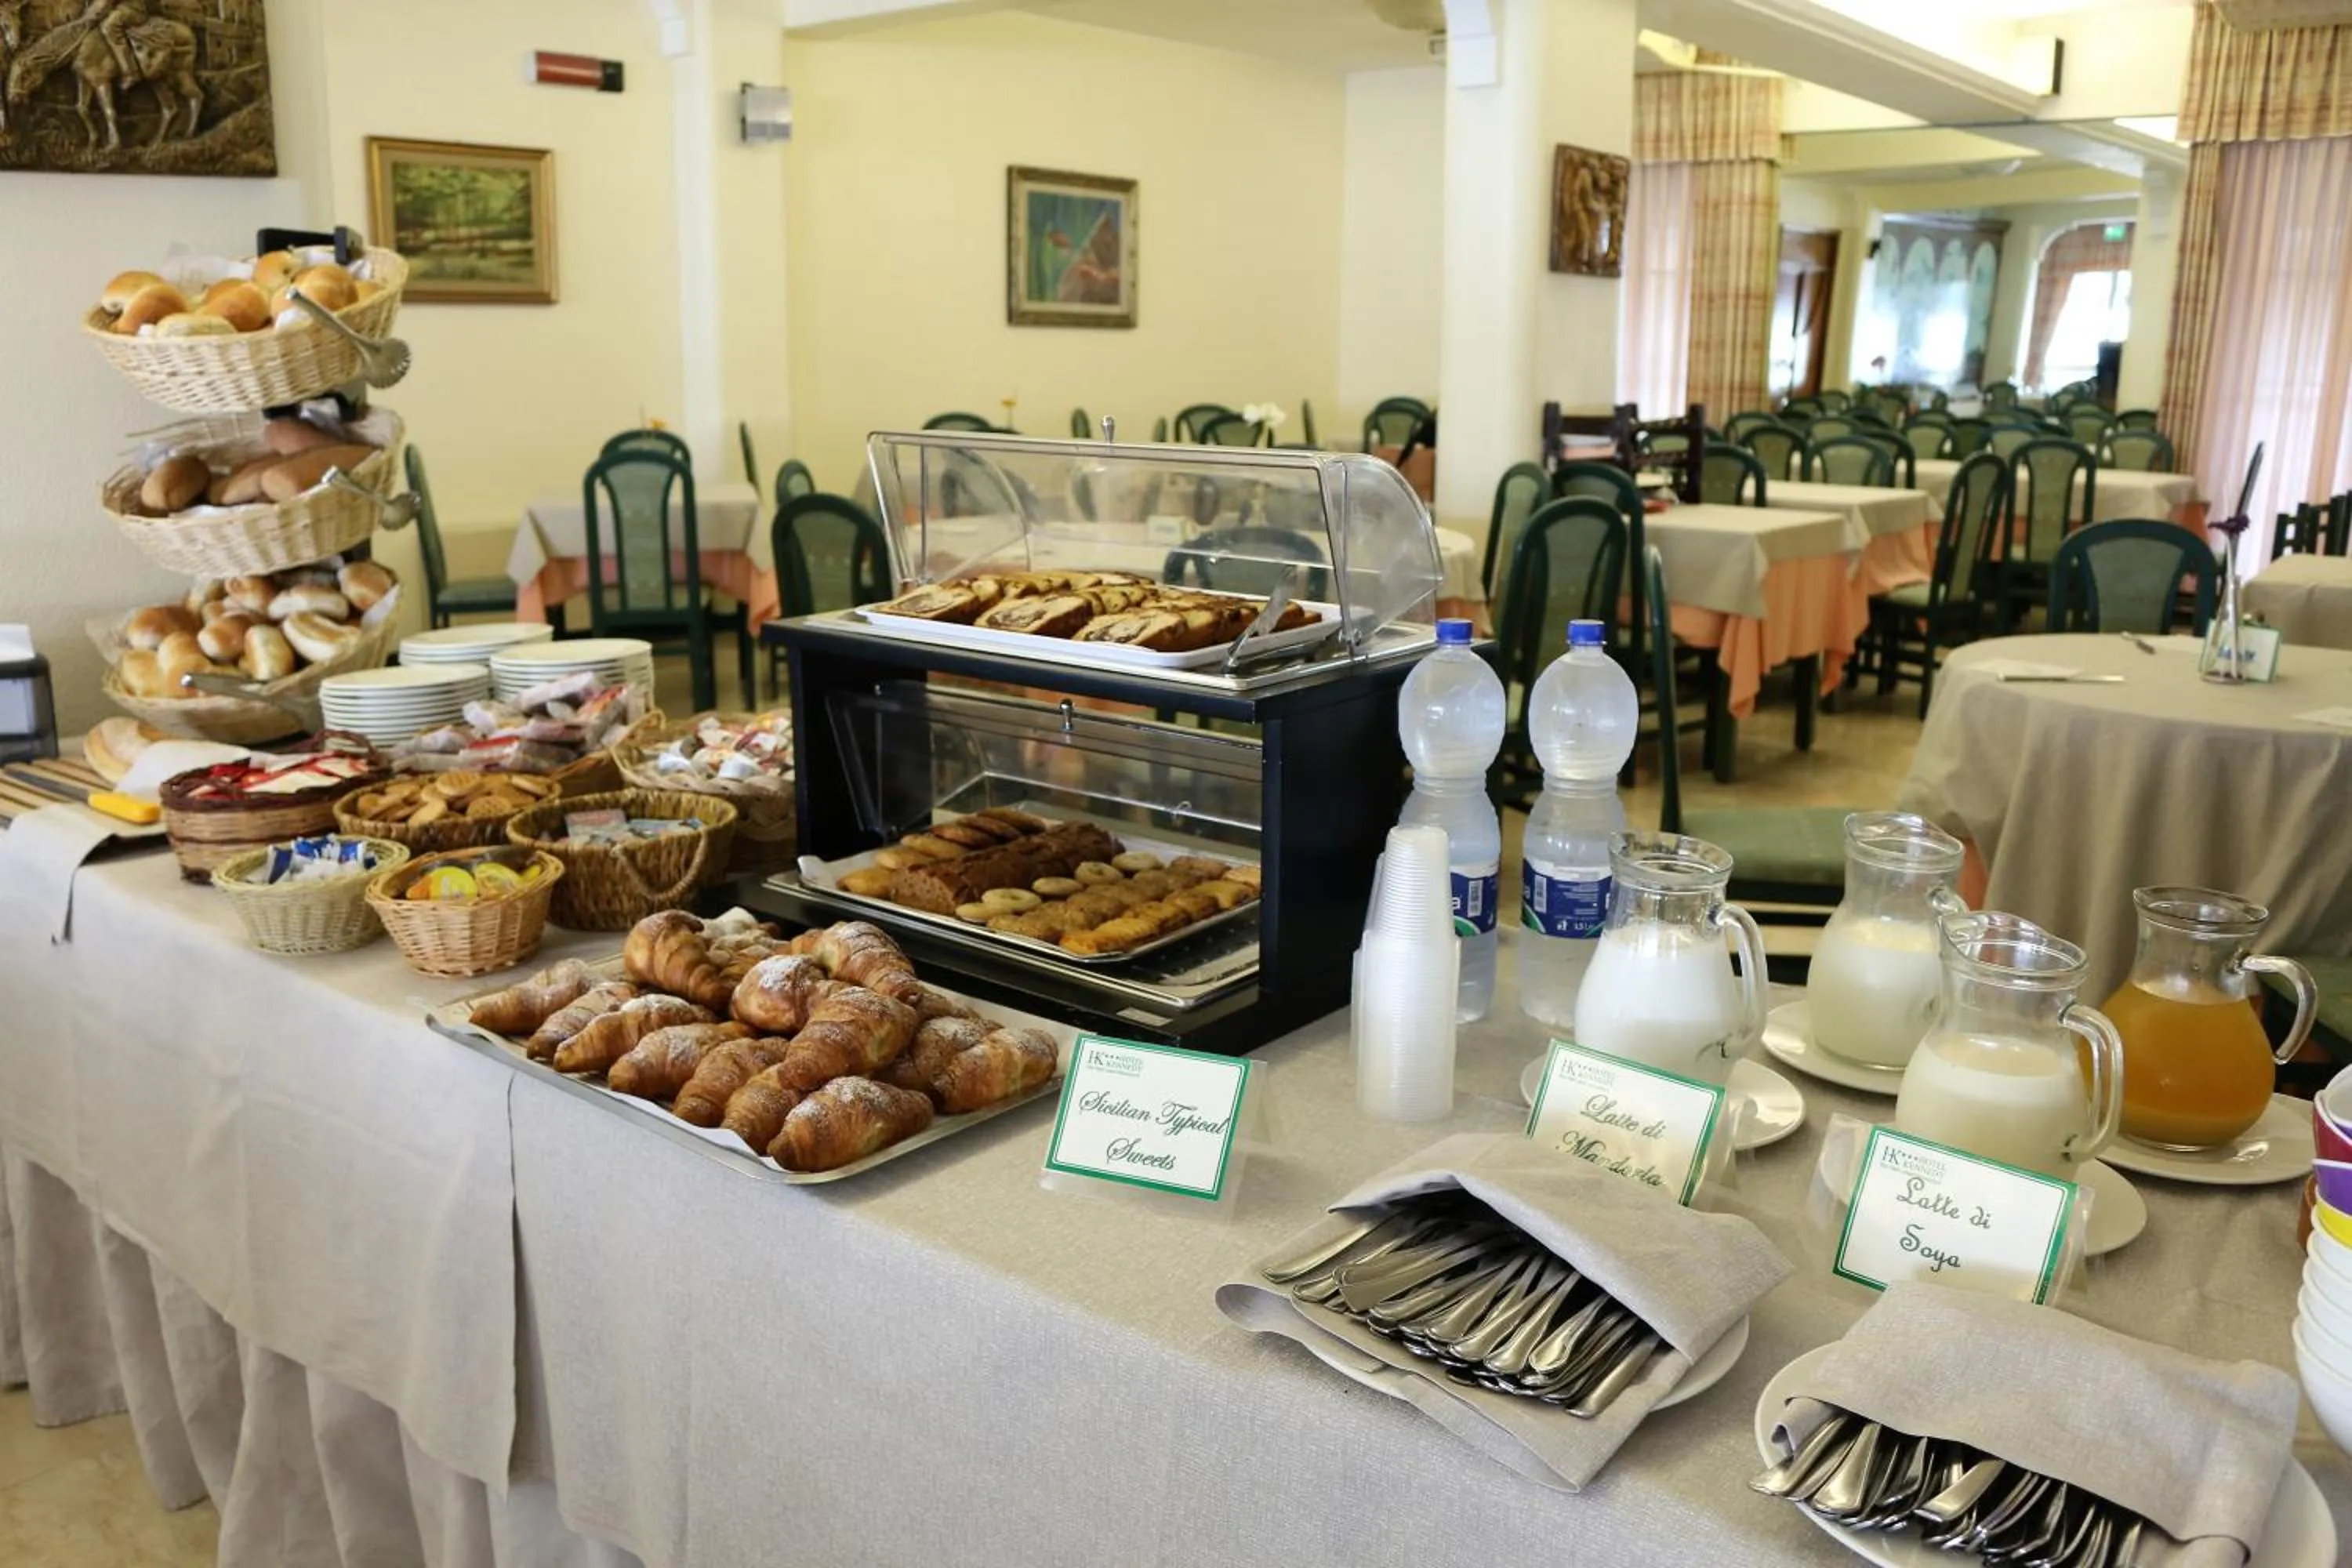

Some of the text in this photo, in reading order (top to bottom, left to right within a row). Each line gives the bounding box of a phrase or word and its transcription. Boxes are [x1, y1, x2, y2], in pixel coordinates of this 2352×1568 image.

[1079, 1091, 1231, 1136] Sicilian Typical
[1580, 1094, 1667, 1140] Latte di
[1106, 1137, 1178, 1171] Sweets
[1896, 1177, 1991, 1229] Latte di
[1900, 1224, 1961, 1272] Soya
